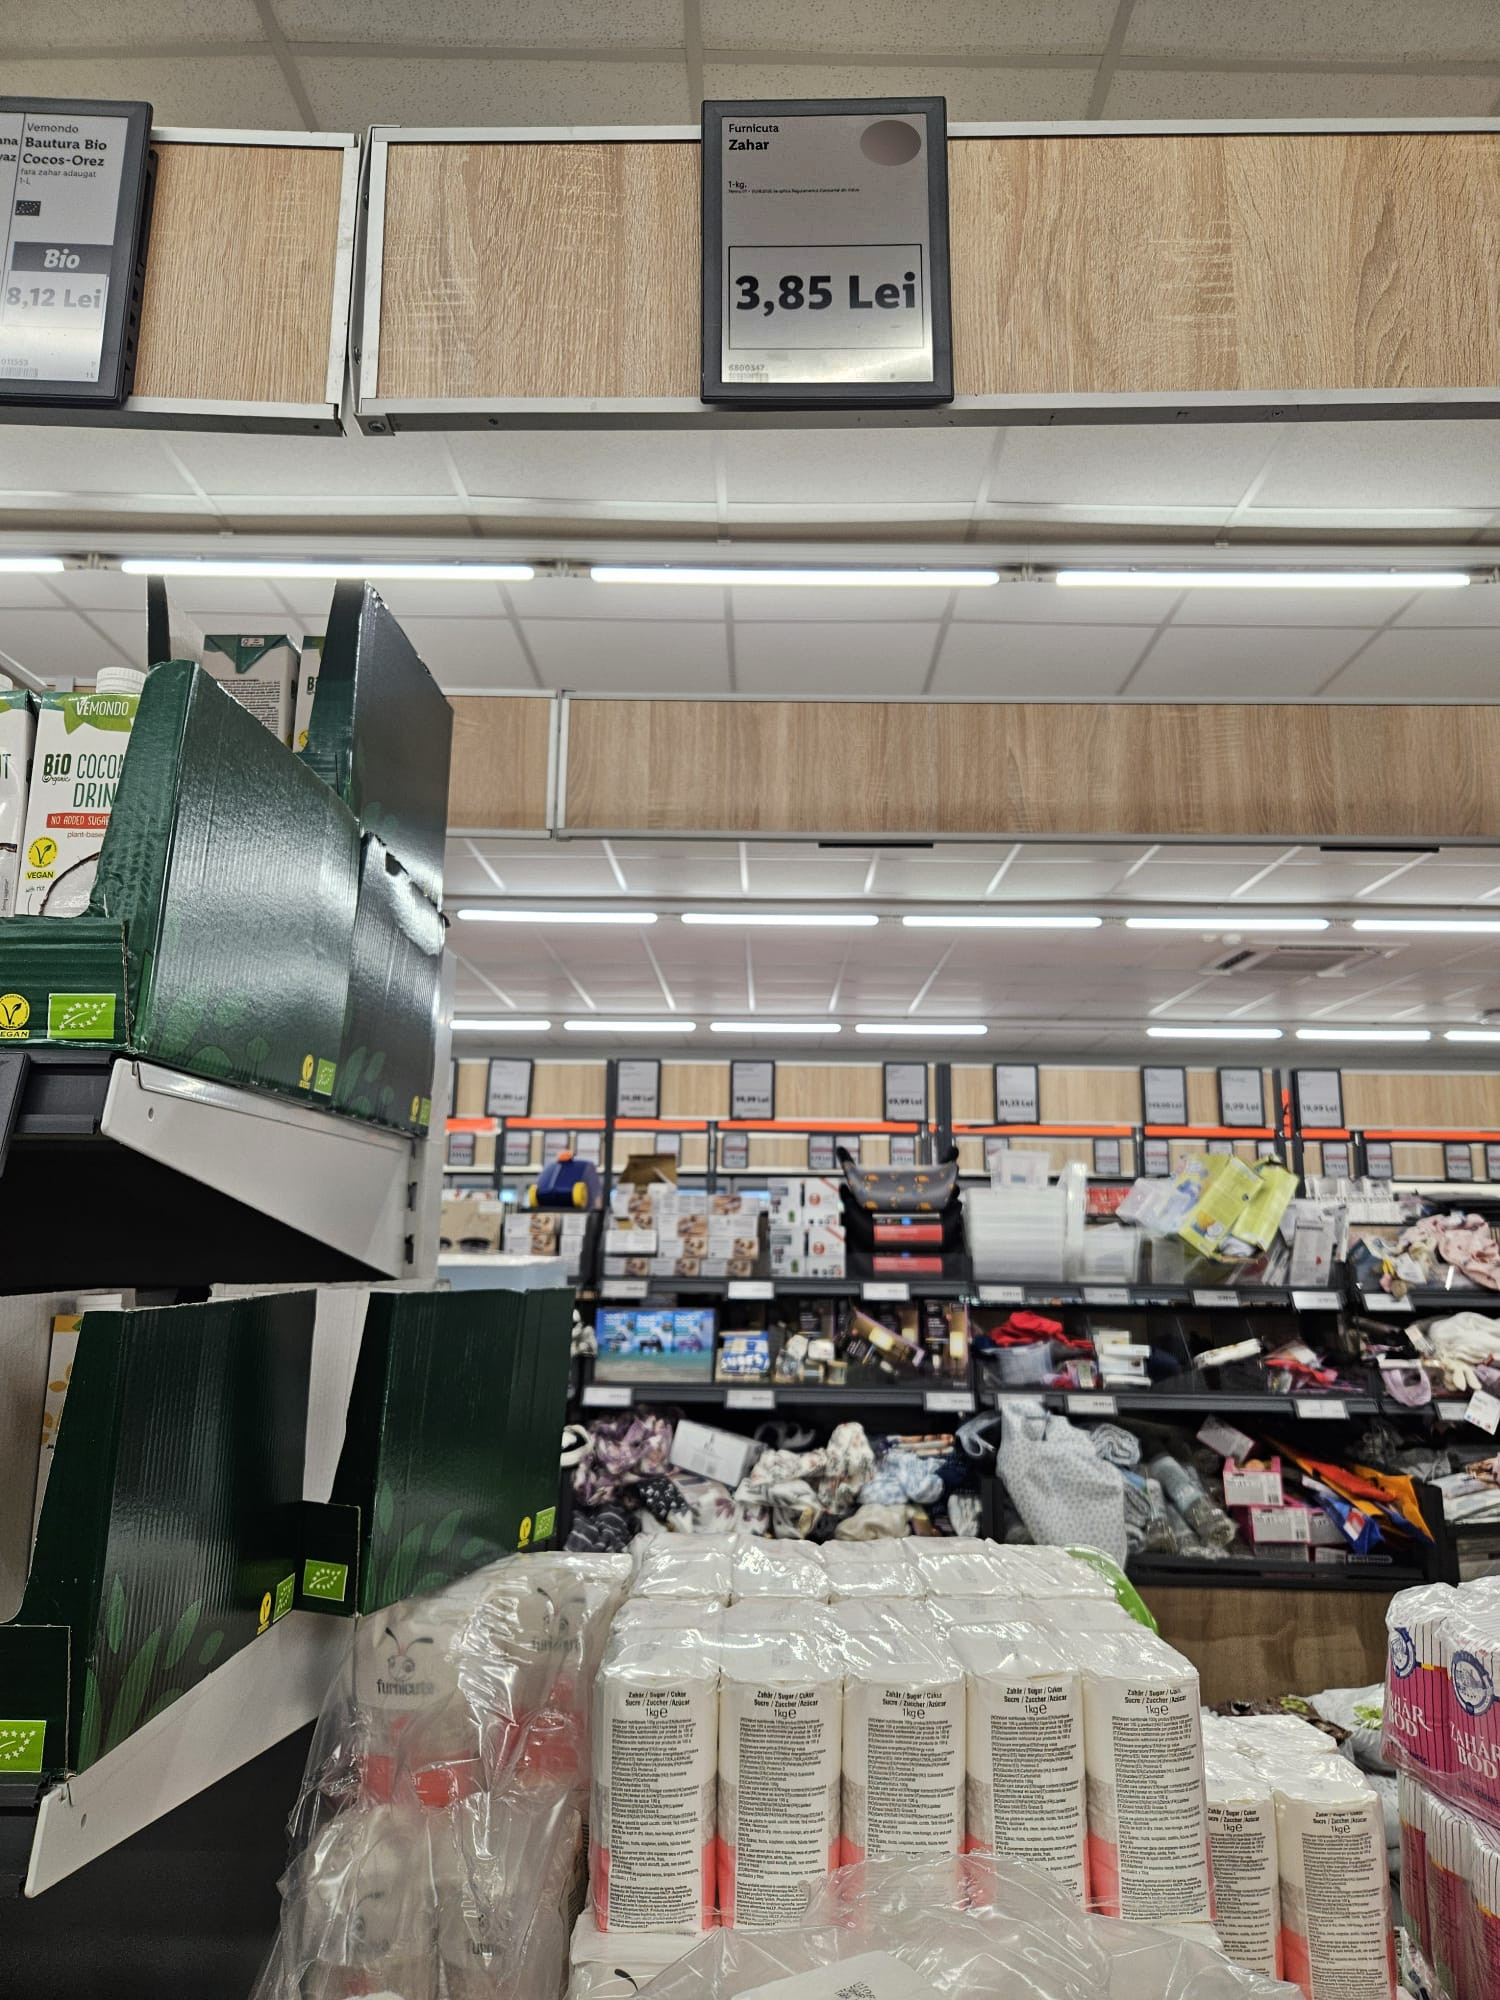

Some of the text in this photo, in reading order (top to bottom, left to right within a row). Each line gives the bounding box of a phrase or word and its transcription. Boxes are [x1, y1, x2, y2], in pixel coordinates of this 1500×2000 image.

[27, 123, 79, 134] Vemondo
[728, 123, 779, 134] Furnicuta
[25, 137, 107, 150] Bautura Bio
[728, 139, 770, 151] Zahar
[22, 153, 105, 167] Cocos-Orez
[43, 248, 80, 269] Bio
[7, 287, 102, 309] 8,12 Lei
[735, 272, 916, 317] 3,85 Lei
[76, 700, 129, 716] VEMONDO
[73, 783, 116, 808] DRIN
[50, 815, 60, 825] NO
[64, 815, 85, 826] ADDED
[67, 831, 104, 840] plant-base
[27, 871, 54, 879] VEGAN
[1391, 1695, 1432, 1731] HĂR
[1458, 1744, 1498, 1779] BOD
